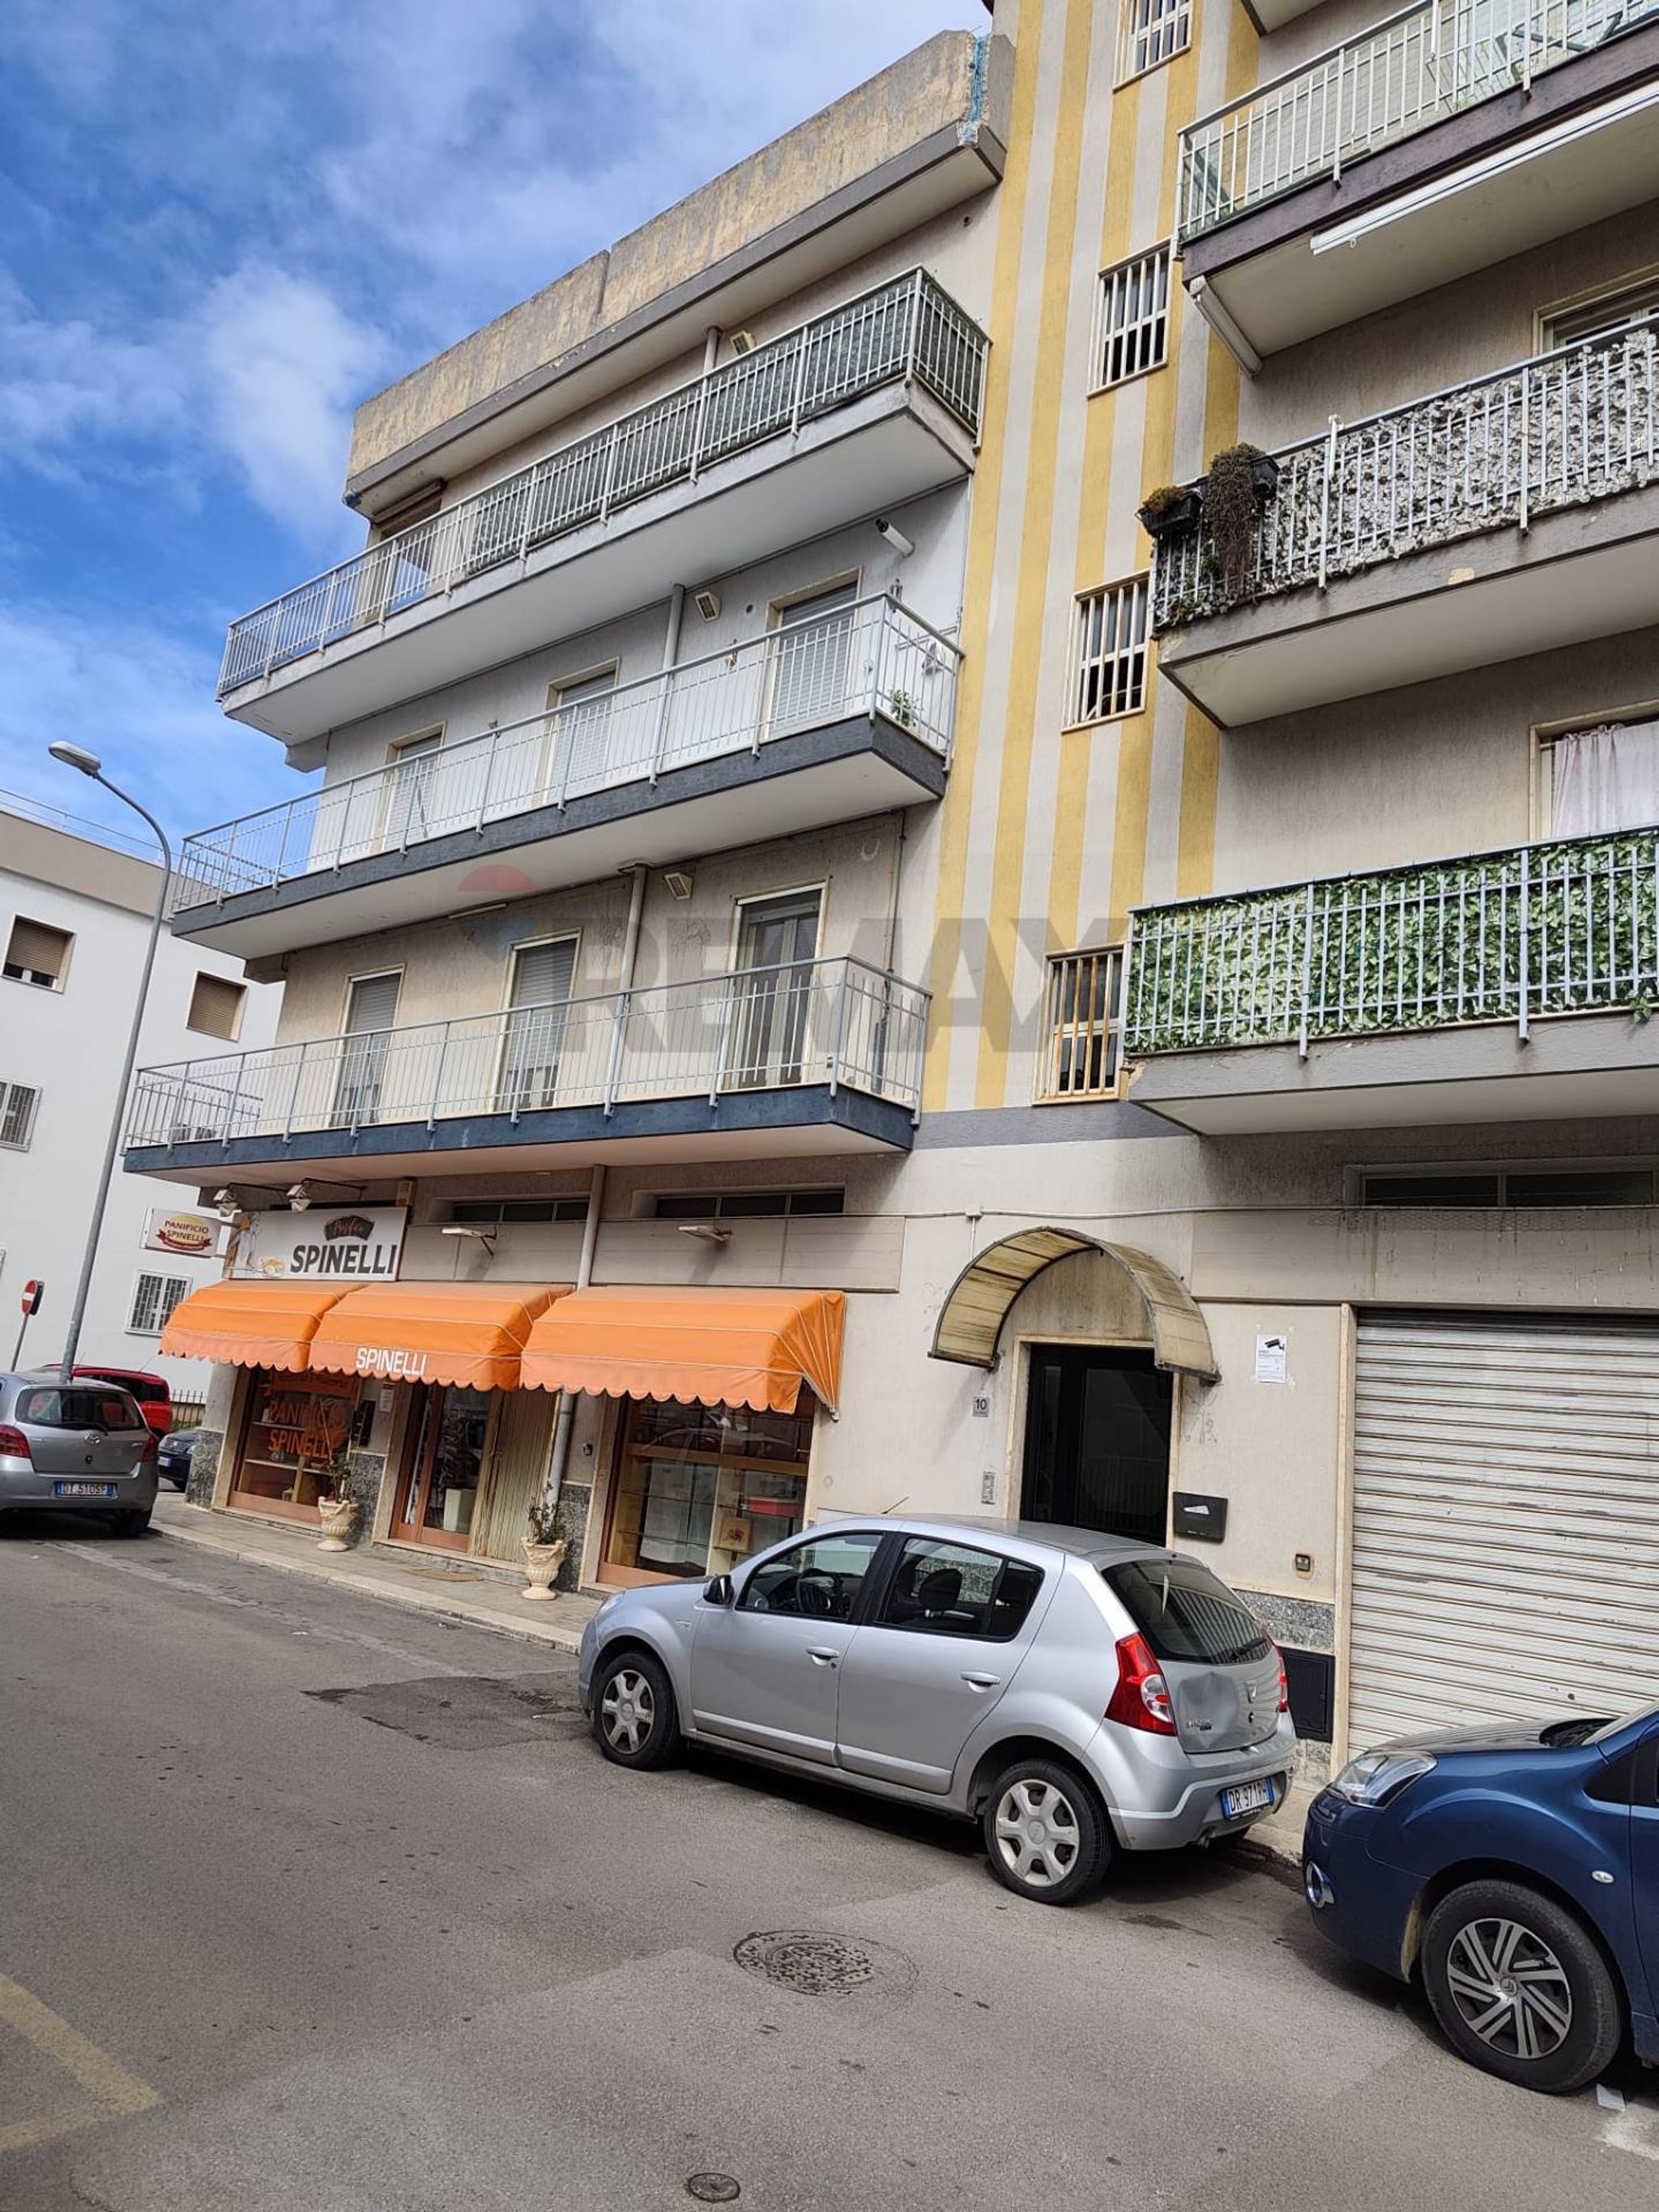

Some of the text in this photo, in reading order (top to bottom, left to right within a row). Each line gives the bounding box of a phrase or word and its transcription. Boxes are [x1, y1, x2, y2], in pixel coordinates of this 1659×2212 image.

[164, 1220, 209, 1234] PANIFICIO
[168, 1230, 204, 1242] SPINELLI
[290, 1244, 398, 1274] SPINELLI
[356, 1347, 428, 1376] SPINELLI
[975, 1398, 987, 1411] 10
